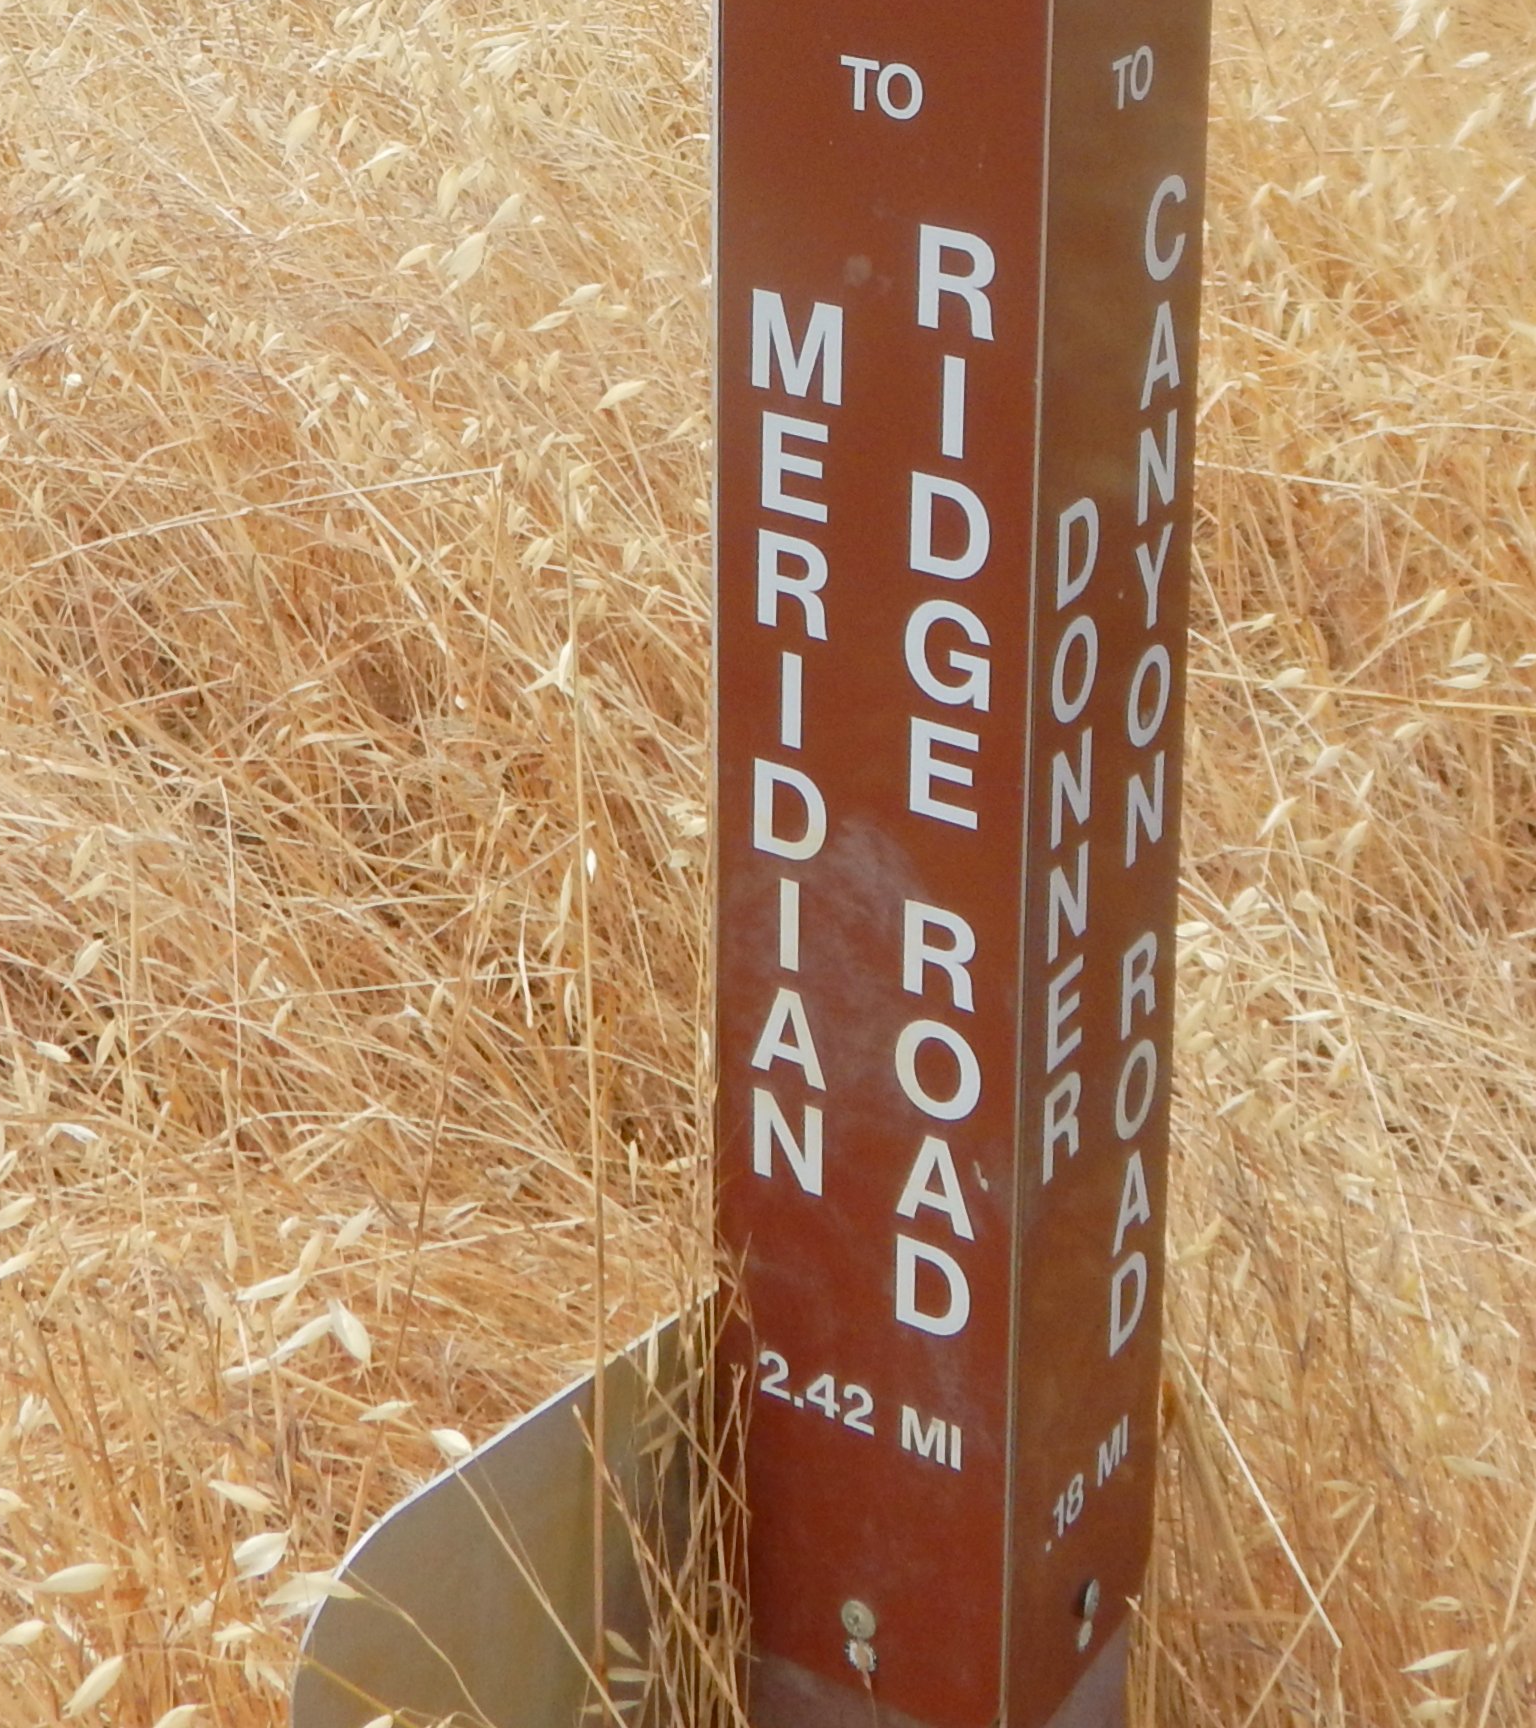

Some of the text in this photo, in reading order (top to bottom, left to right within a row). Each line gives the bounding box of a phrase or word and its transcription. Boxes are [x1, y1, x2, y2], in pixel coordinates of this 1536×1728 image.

[840, 54, 923, 120] TO
[1112, 45, 1154, 110] TO
[750, 287, 844, 1197] MERIDIAN
[895, 223, 996, 1337] RIDGE ROAD
[1041, 496, 1099, 1186] DONNER
[1109, 174, 1187, 1359] CANYON ROAD
[759, 1350, 962, 1472] 2.42 MI
[1097, 1415, 1129, 1487] MI
